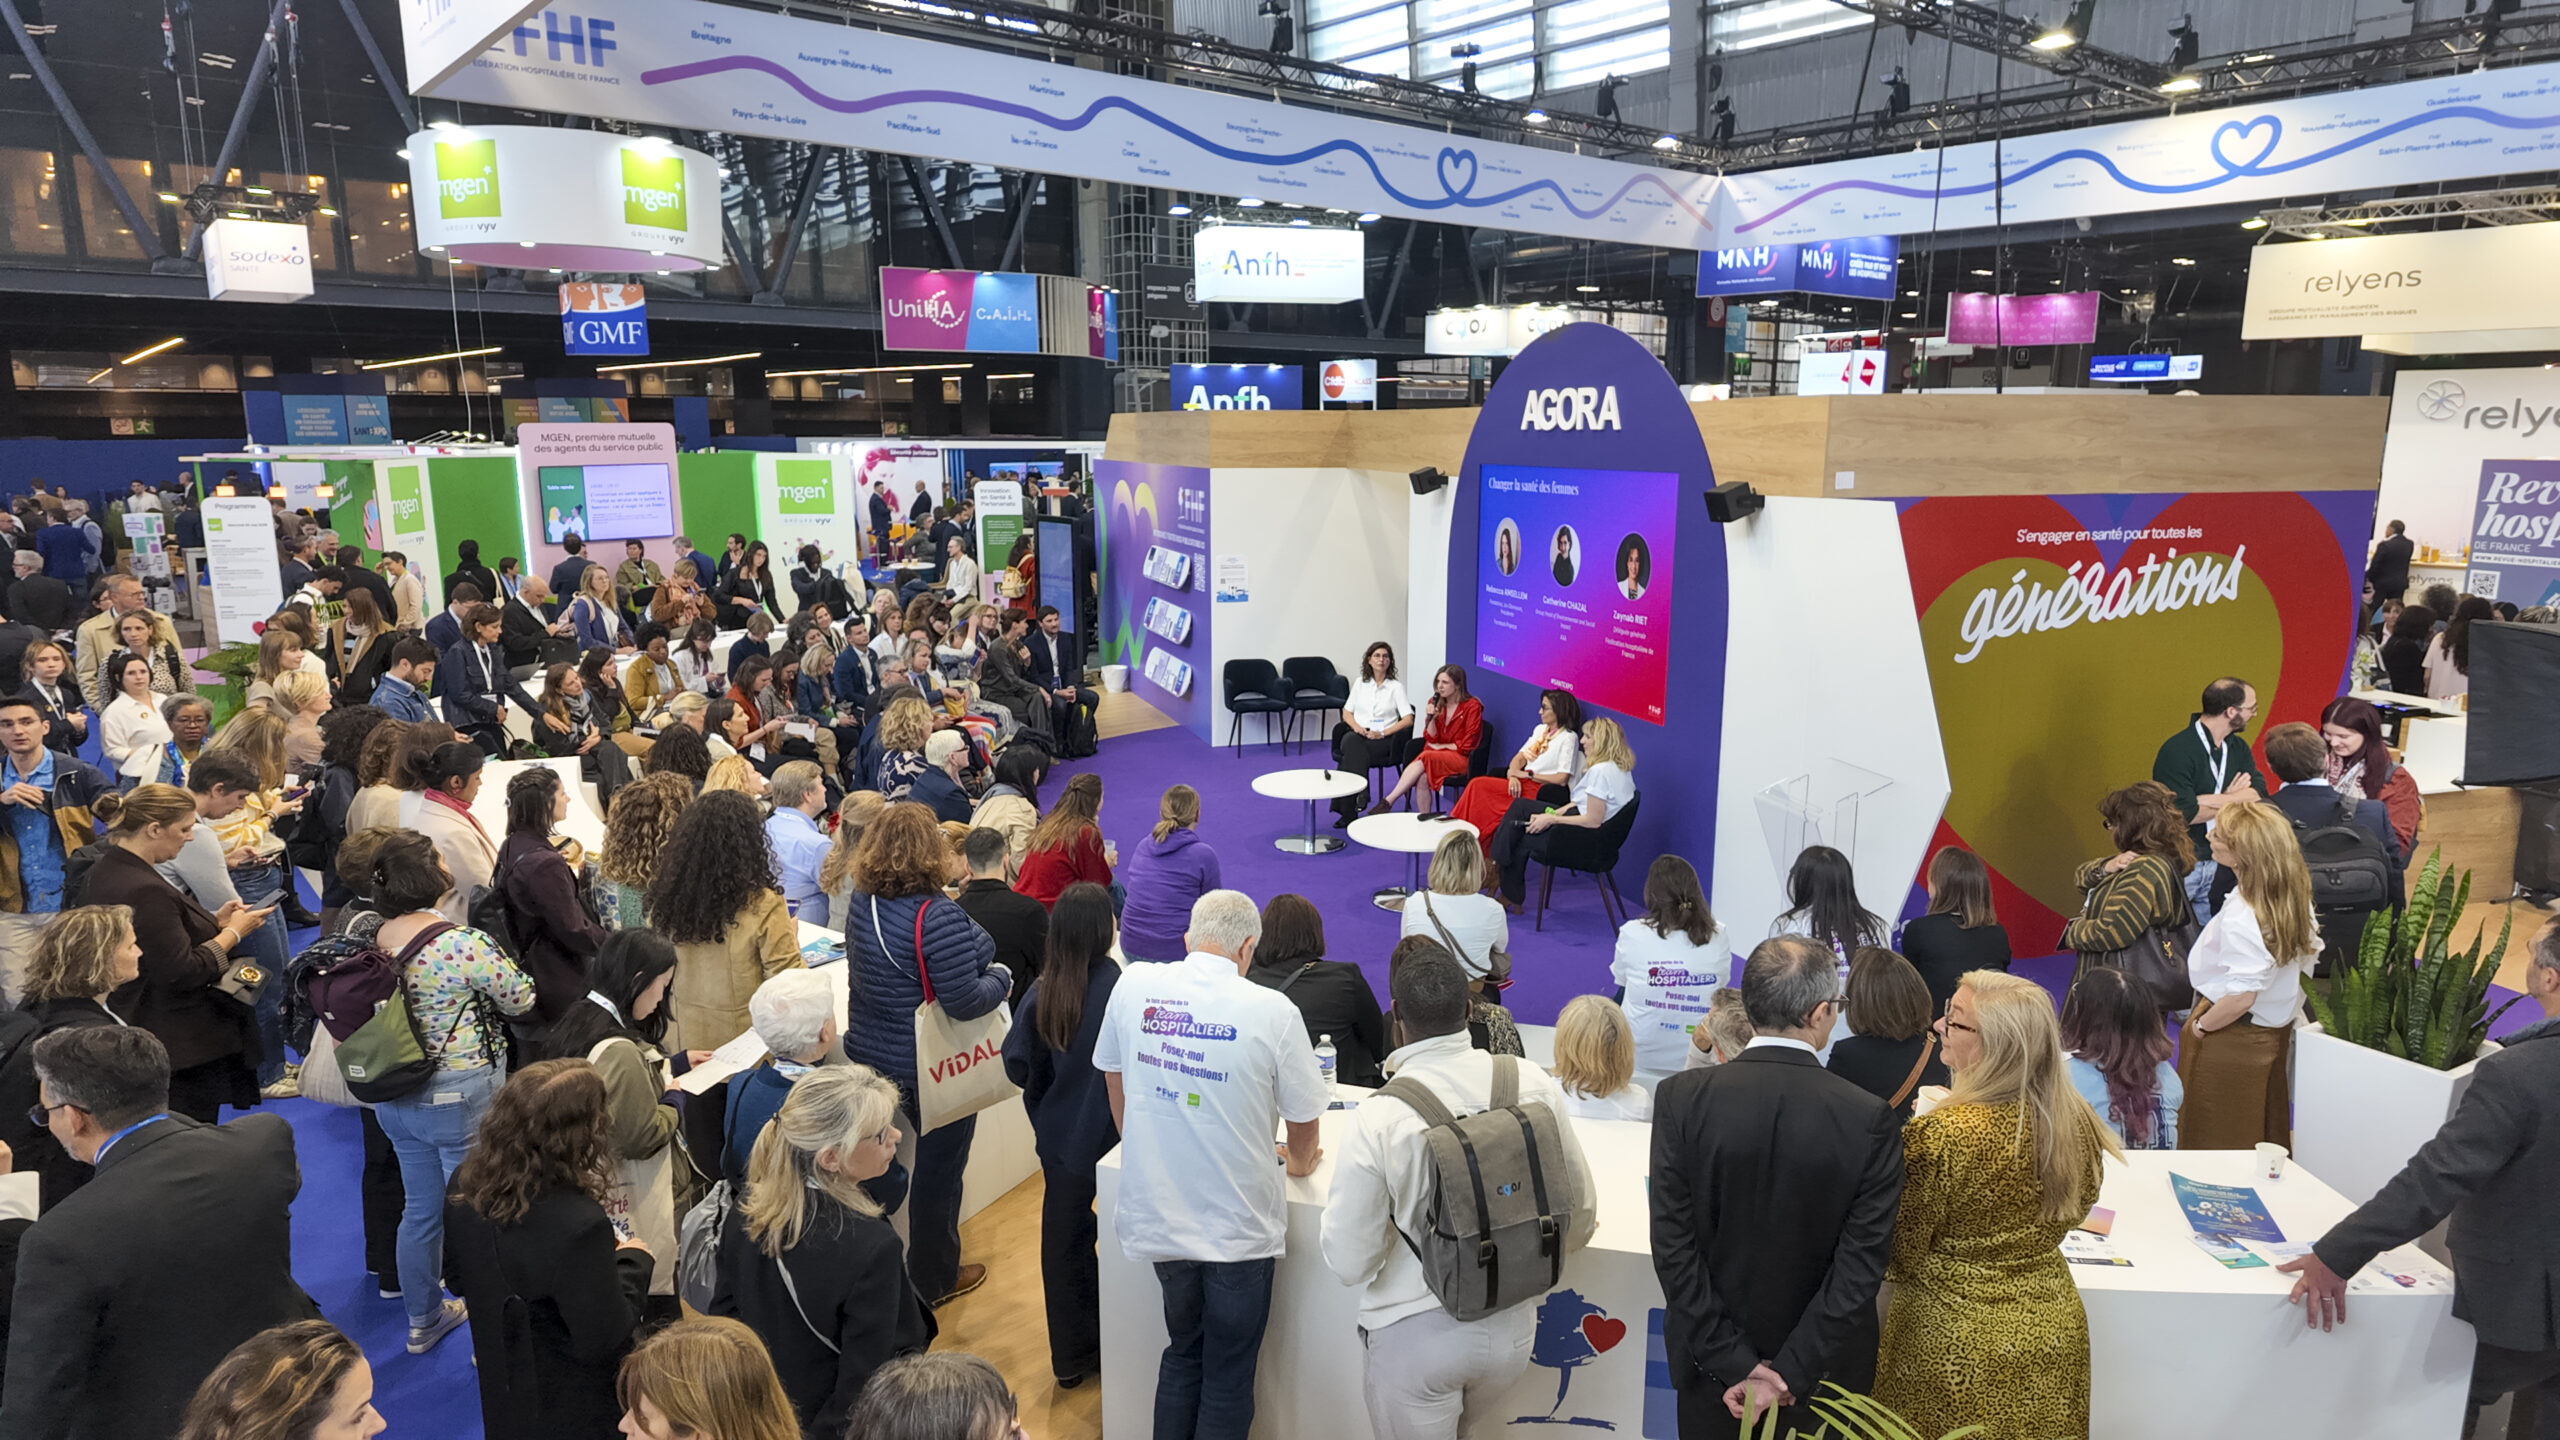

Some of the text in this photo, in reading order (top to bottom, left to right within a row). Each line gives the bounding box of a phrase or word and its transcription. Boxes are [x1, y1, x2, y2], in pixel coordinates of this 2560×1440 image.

[691, 30, 732, 45] Bretagne
[473, 60, 520, 73] ÉDÉRATION
[589, 75, 620, 85] FRANCE
[798, 52, 893, 75] Auvergne-Rhône-Alpes
[1028, 84, 1065, 97] Martinique
[2426, 93, 2482, 107] Guadeloupe
[732, 108, 807, 126] Pays-de-la-Loire
[2300, 117, 2381, 133] Nouvelle-Aquitaine
[886, 120, 941, 136] Pacifique-Sud
[1010, 134, 1058, 150] Île-de-France
[2378, 136, 2493, 156] Saint-Pierre-et-Miquelon
[1122, 148, 1141, 159] Corse
[1137, 165, 1171, 177] Normandie
[439, 177, 489, 203] mgen
[623, 185, 679, 212] mgen
[477, 222, 497, 232] vyv
[668, 234, 685, 245] vyv
[230, 250, 305, 265] sodexo
[1221, 249, 1290, 277] Anfh
[1717, 246, 1770, 270] MNH
[1801, 248, 1834, 270] MNH
[2304, 269, 2423, 297] relyens
[888, 298, 955, 319] UniHA
[580, 320, 643, 345] GMF
[1183, 385, 1271, 411] Anfh
[1520, 385, 1622, 431] AGORA
[2464, 397, 2560, 438] rely
[541, 432, 655, 444] MGEN, première mutuelle
[534, 442, 663, 455] des agents du service public
[779, 484, 826, 503] mgen
[1488, 477, 1513, 492] Changer
[1521, 479, 1538, 493] santé
[1539, 480, 1551, 494] des
[1552, 481, 1579, 496] femmes
[214, 503, 256, 513] Programme
[392, 496, 419, 520] mgen
[2017, 525, 2202, 546] S'engager en santé pour toutes les
[2474, 540, 2531, 553] DE FRANCE
[1954, 544, 2246, 664] générations
[1647, 973, 1716, 987] HOSPITALIERS
[1645, 999, 1666, 1009] toutes
[1668, 1002, 1680, 1010] vos
[1665, 991, 1700, 1002] Posez-moi
[1144, 1005, 1189, 1023] #team
[1141, 1018, 1233, 1039] HOSPITALIERS
[1161, 1042, 1205, 1063] Posez-moi
[1138, 1051, 1161, 1067] toutes
[1163, 1056, 1178, 1071] vos
[1180, 1058, 1222, 1082] questions
[1162, 1088, 1180, 1101] FHF
